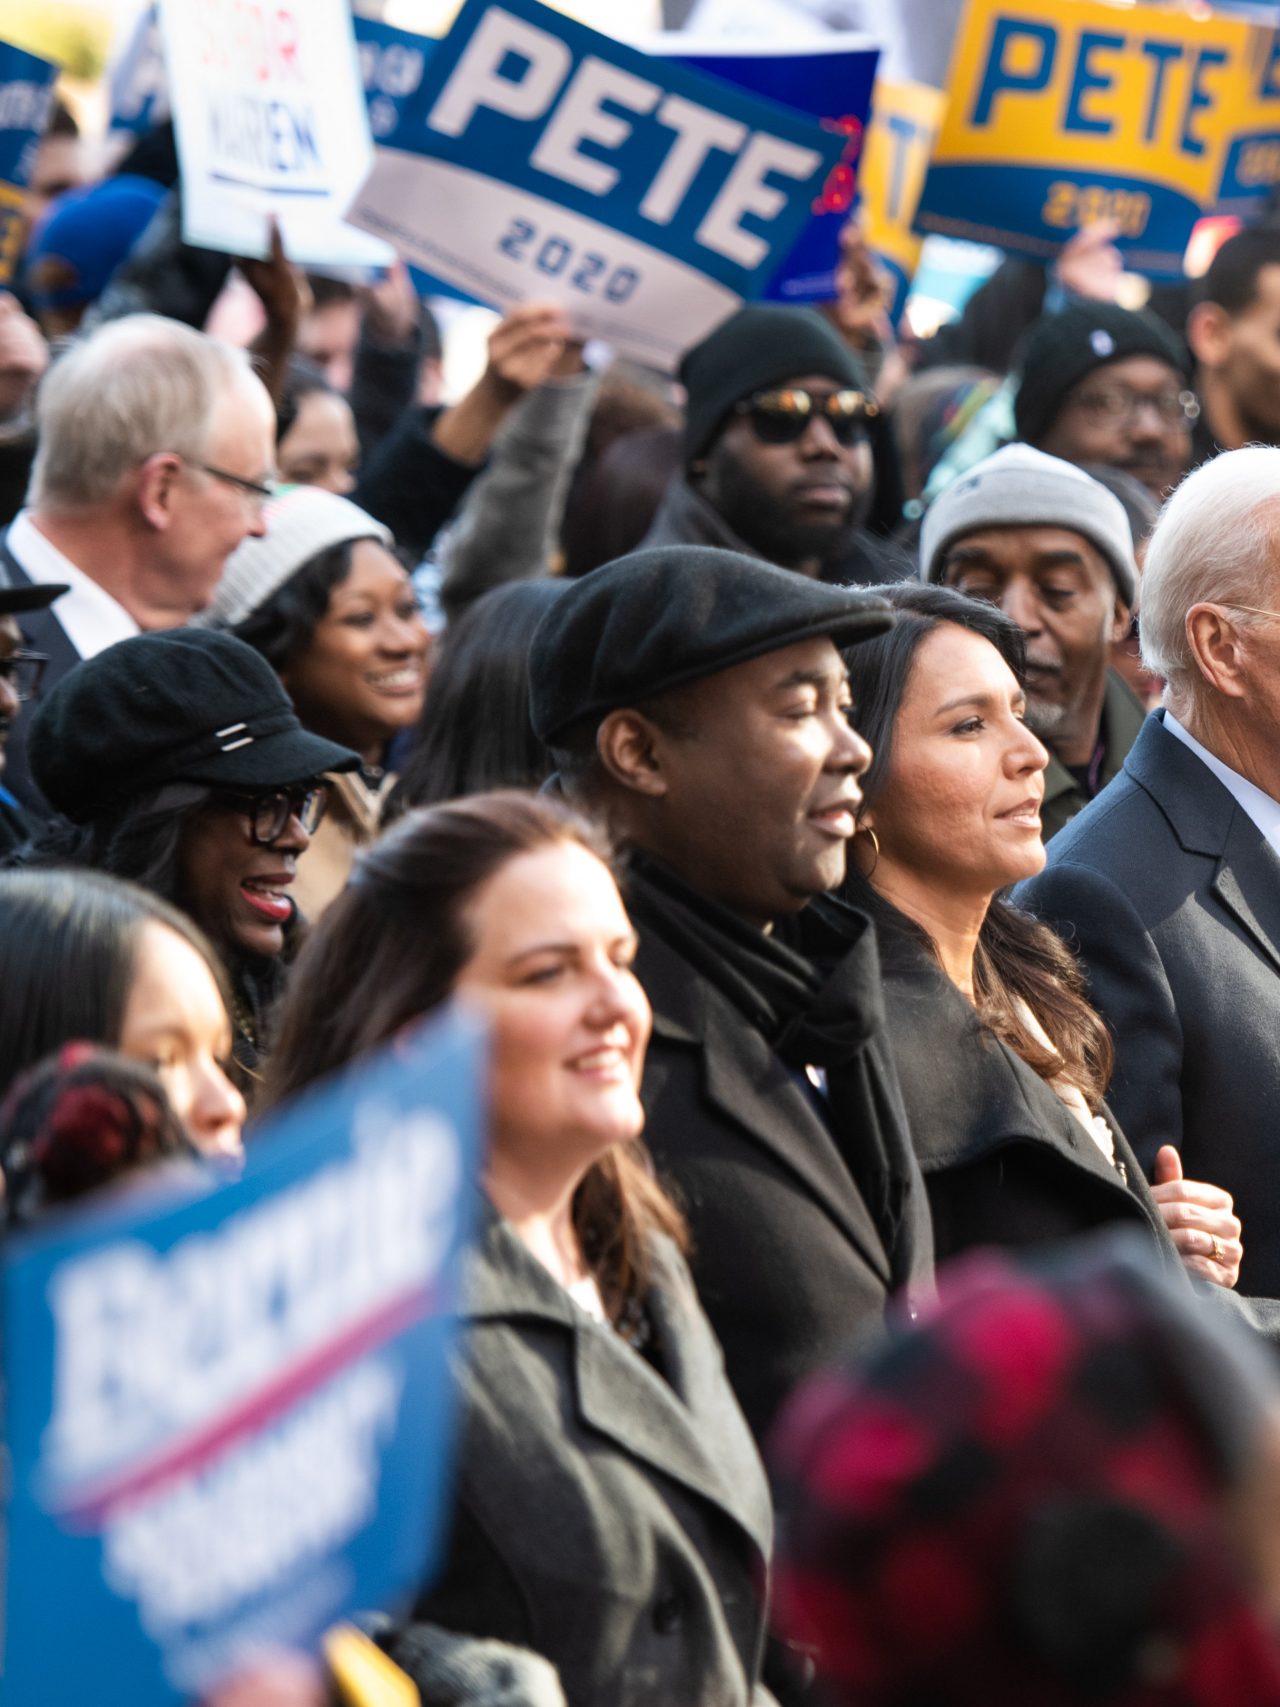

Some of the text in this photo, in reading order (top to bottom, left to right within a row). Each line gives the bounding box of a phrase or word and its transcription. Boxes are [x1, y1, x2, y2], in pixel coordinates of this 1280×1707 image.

[427, 4, 824, 271] PETE
[969, 16, 1229, 157] PETE
[498, 214, 643, 306] 2020
